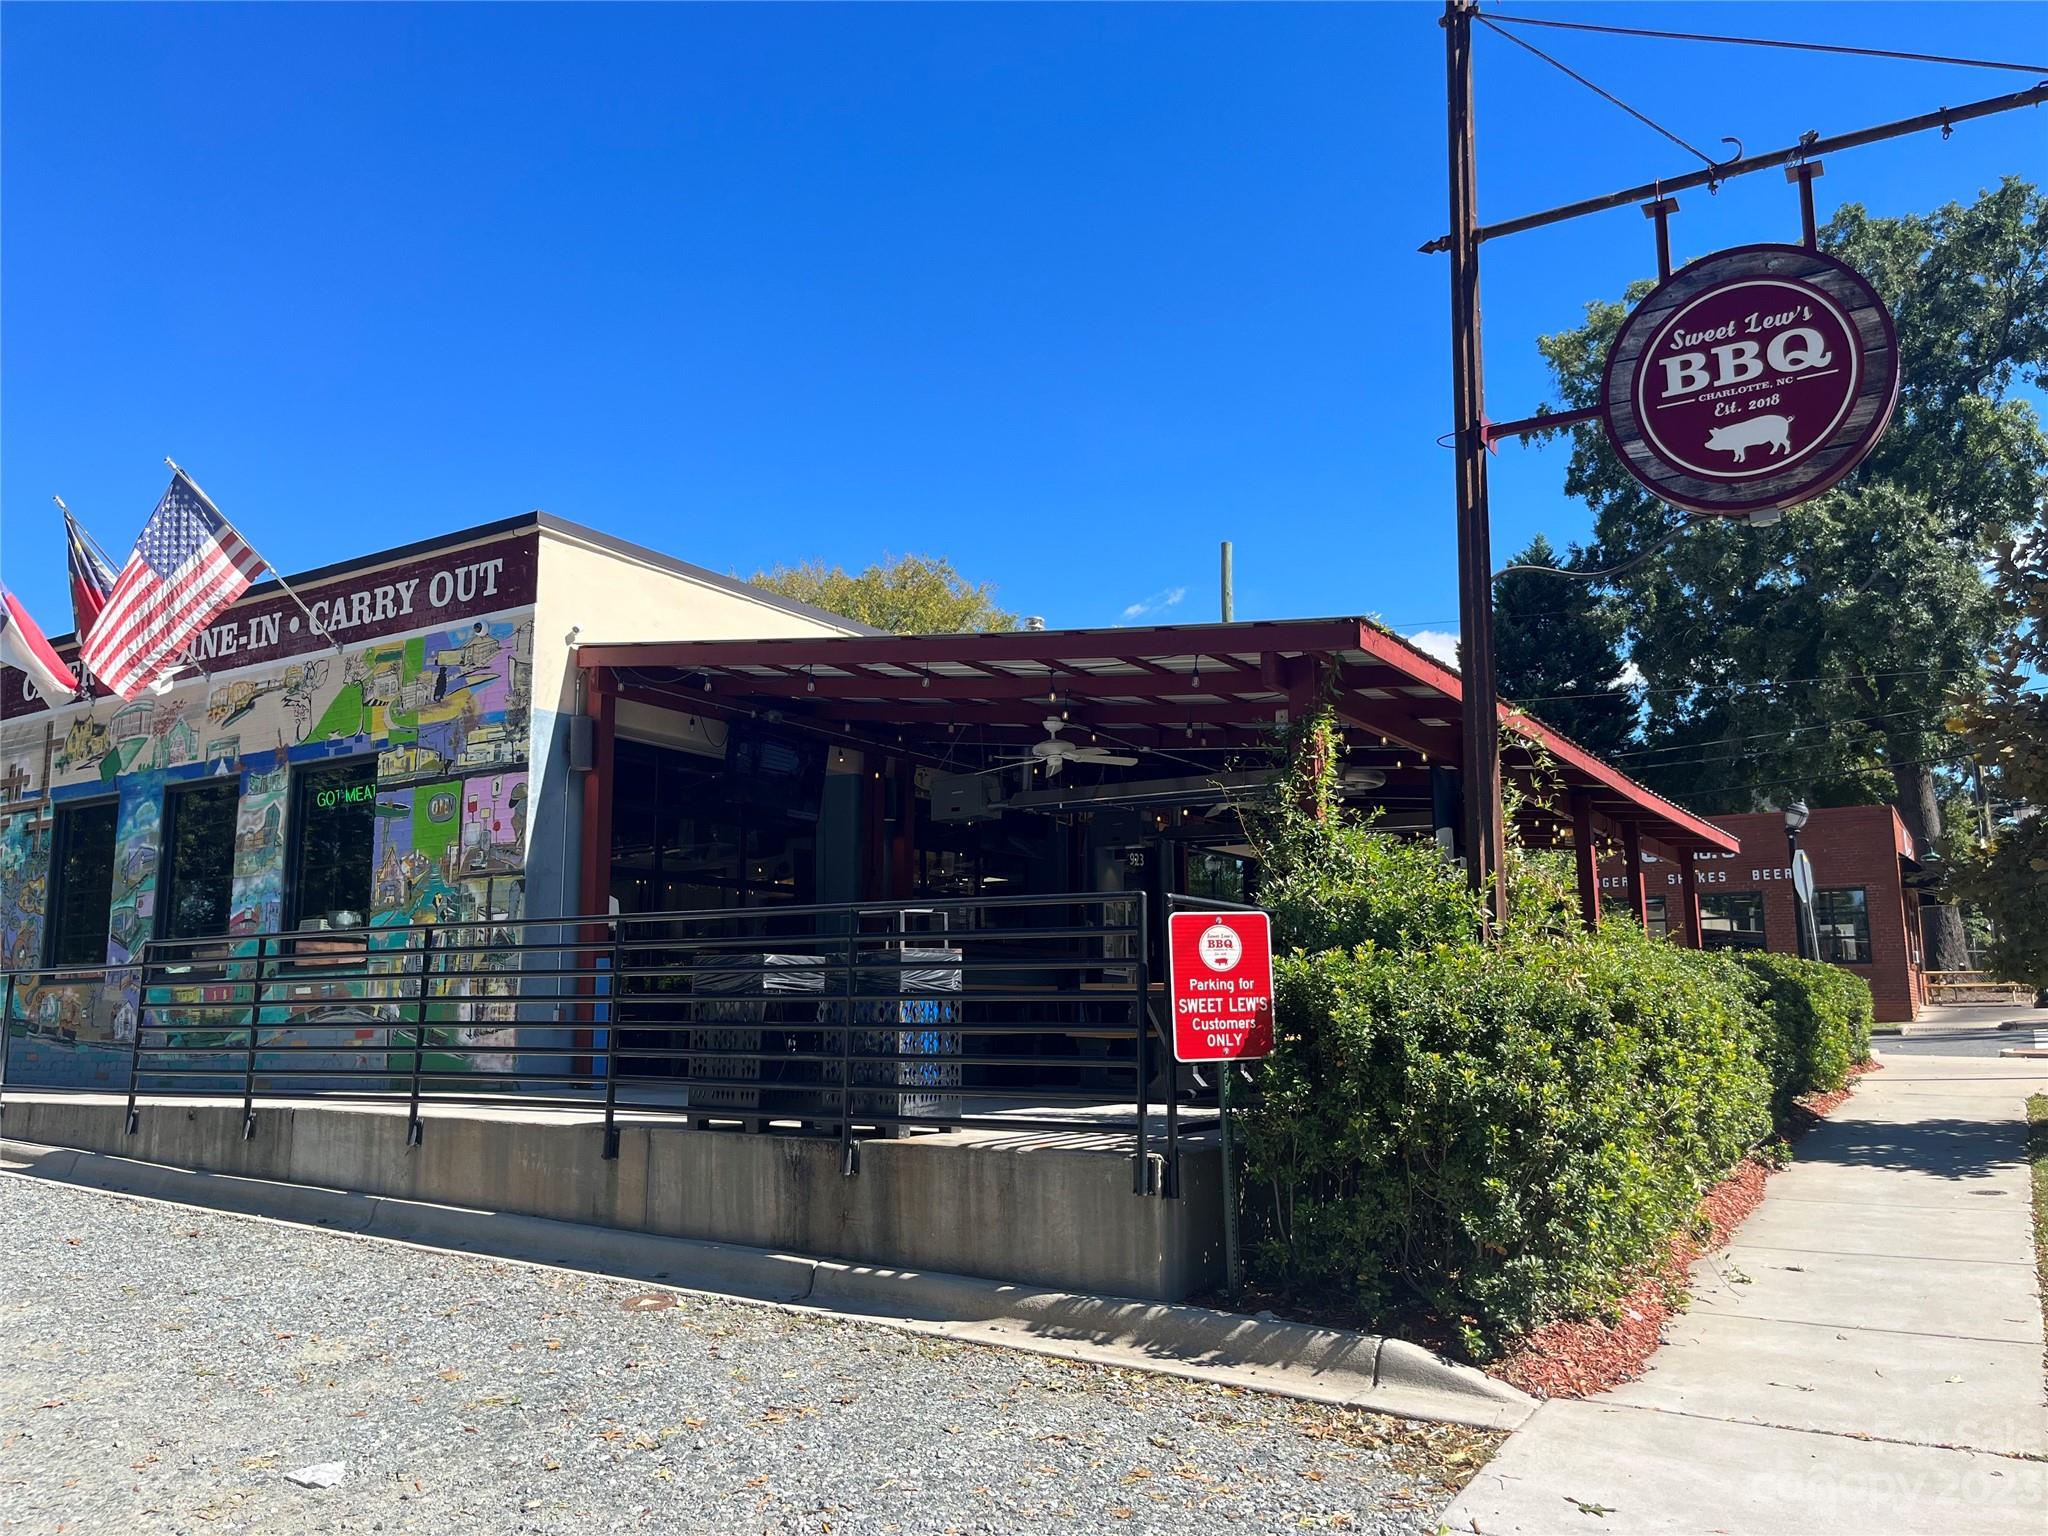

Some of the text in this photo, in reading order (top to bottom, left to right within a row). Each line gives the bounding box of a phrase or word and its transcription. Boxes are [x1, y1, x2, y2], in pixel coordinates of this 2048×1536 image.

[1670, 305, 1812, 349] Sweet Lew's
[1659, 327, 1832, 397] BBQ
[1698, 376, 1793, 401] CHARLOTTE, NC
[1714, 393, 1780, 416] Est. 2018
[308, 577, 419, 636] CARRY
[428, 558, 503, 608] OUT
[1129, 852, 1145, 867] 923
[1207, 939, 1233, 948] BBQ
[1189, 978, 1254, 993] Parking for
[1179, 997, 1268, 1014] SWEET LEW'S
[1192, 1018, 1256, 1031] Customers
[1207, 1034, 1243, 1048] ONLY
